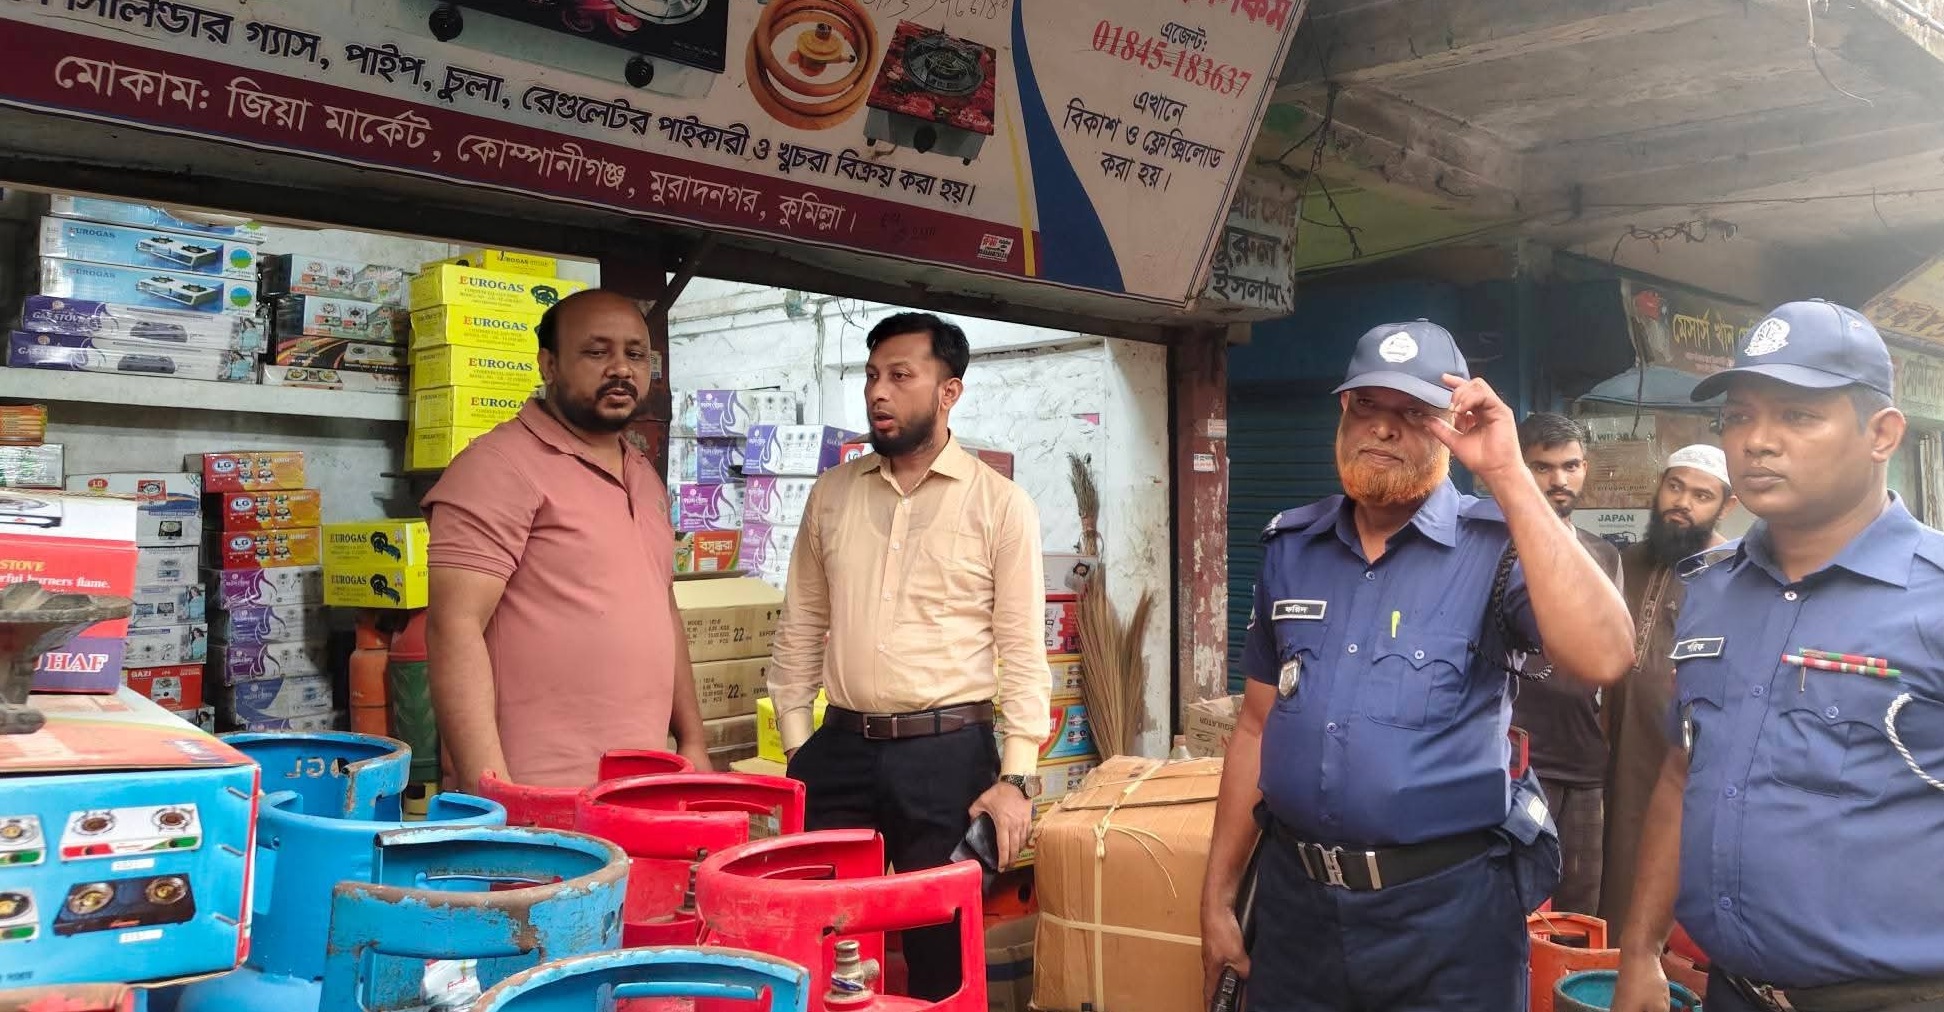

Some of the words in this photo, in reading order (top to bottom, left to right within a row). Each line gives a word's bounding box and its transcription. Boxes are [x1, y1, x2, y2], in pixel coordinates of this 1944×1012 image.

[1092, 19, 1253, 98] 01845-183637
[245, 21, 331, 72] গ্যাস,
[345, 42, 432, 93] পাইপ,
[437, 64, 511, 111] চুলা,
[657, 115, 751, 158] পাইকারী
[753, 137, 770, 161] ও
[777, 141, 831, 176] খুচরা
[834, 151, 897, 189] বিক্রয়
[898, 170, 936, 196] করা
[1133, 91, 1188, 126] এখানে
[1063, 97, 1122, 143] বিকাশ
[1125, 125, 1139, 147] ও
[55, 55, 212, 111] মোকাম:
[227, 76, 313, 132] জিয়া
[649, 170, 767, 221] মুরাদনগর,
[1100, 151, 1135, 183] করা
[458, 275, 525, 293] EUROGAS
[463, 315, 528, 332] EUROGAS
[468, 357, 533, 372] EUROGAS
[471, 396, 526, 409] EUROGA
[217, 461, 232, 469] LG
[1597, 514, 1635, 522] JAPAN
[330, 533, 367, 543] EUROGAS
[76, 577, 111, 589] flame.
[331, 574, 367, 585] EUROGAS
[733, 626, 745, 642] 22
[131, 669, 152, 678] GAZI
[727, 683, 740, 699] 22
